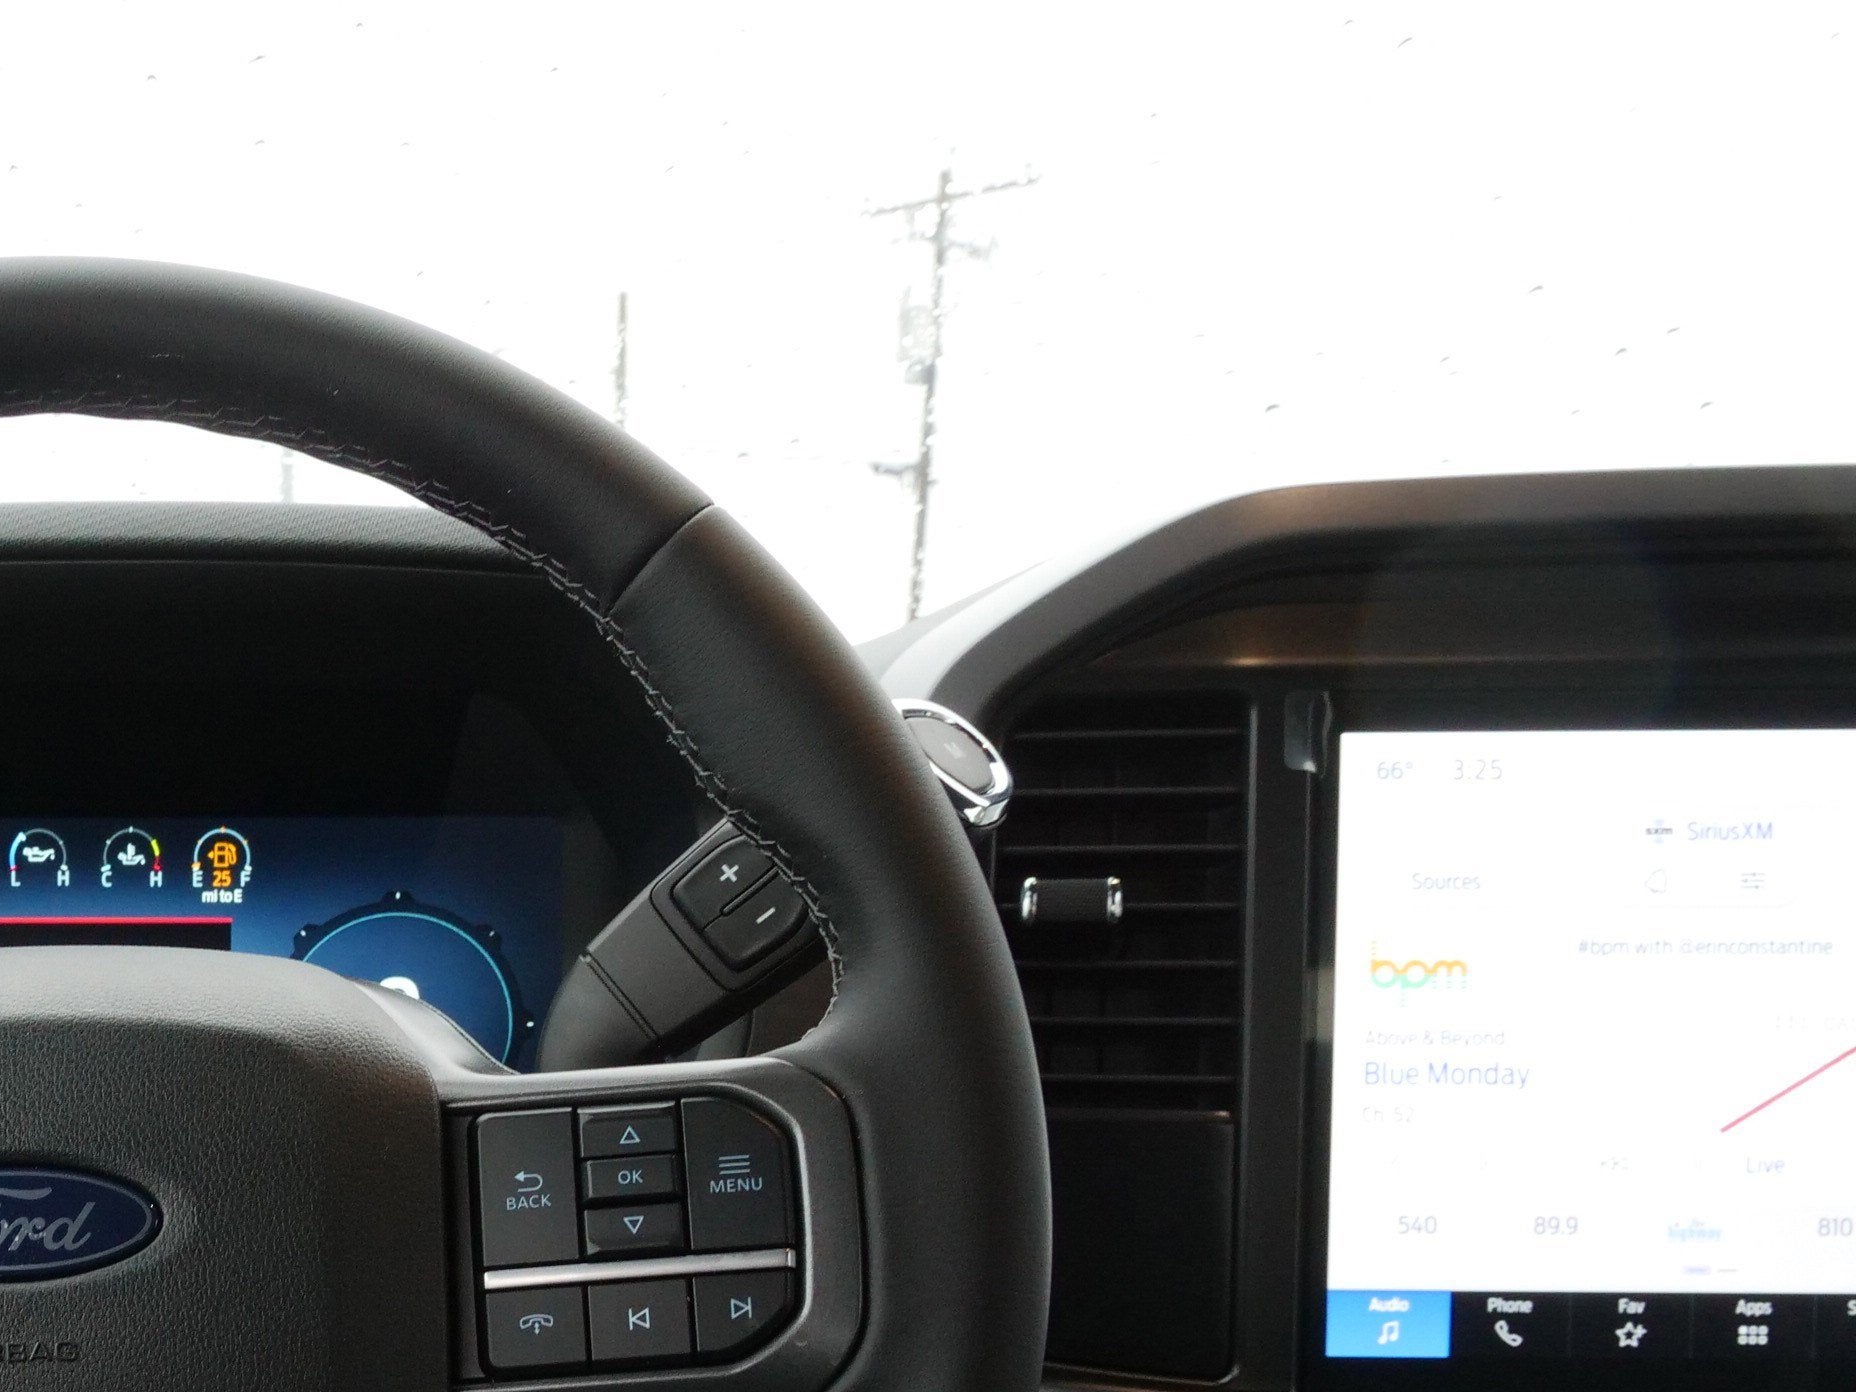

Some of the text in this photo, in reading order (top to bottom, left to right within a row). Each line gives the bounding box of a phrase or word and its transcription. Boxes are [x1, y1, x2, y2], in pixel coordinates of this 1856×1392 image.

[10, 869, 21, 888] L
[56, 869, 70, 887] H
[100, 870, 113, 888] C
[149, 870, 163, 888] H
[192, 870, 204, 888] E
[212, 869, 232, 888] 25
[240, 869, 251, 888] F
[1411, 872, 1481, 890] Sources
[1364, 1061, 1530, 1090] Blue Monday
[617, 1170, 644, 1185] OK
[709, 1177, 763, 1194] MENU
[506, 1194, 552, 1211] BACK
[1397, 1215, 1438, 1235] 540
[1533, 1215, 1579, 1236] 89.9
[1368, 1296, 1410, 1313] Audio
[1486, 1297, 1533, 1314] Phone
[1617, 1298, 1646, 1315] Fav
[1735, 1298, 1773, 1318] Apps
